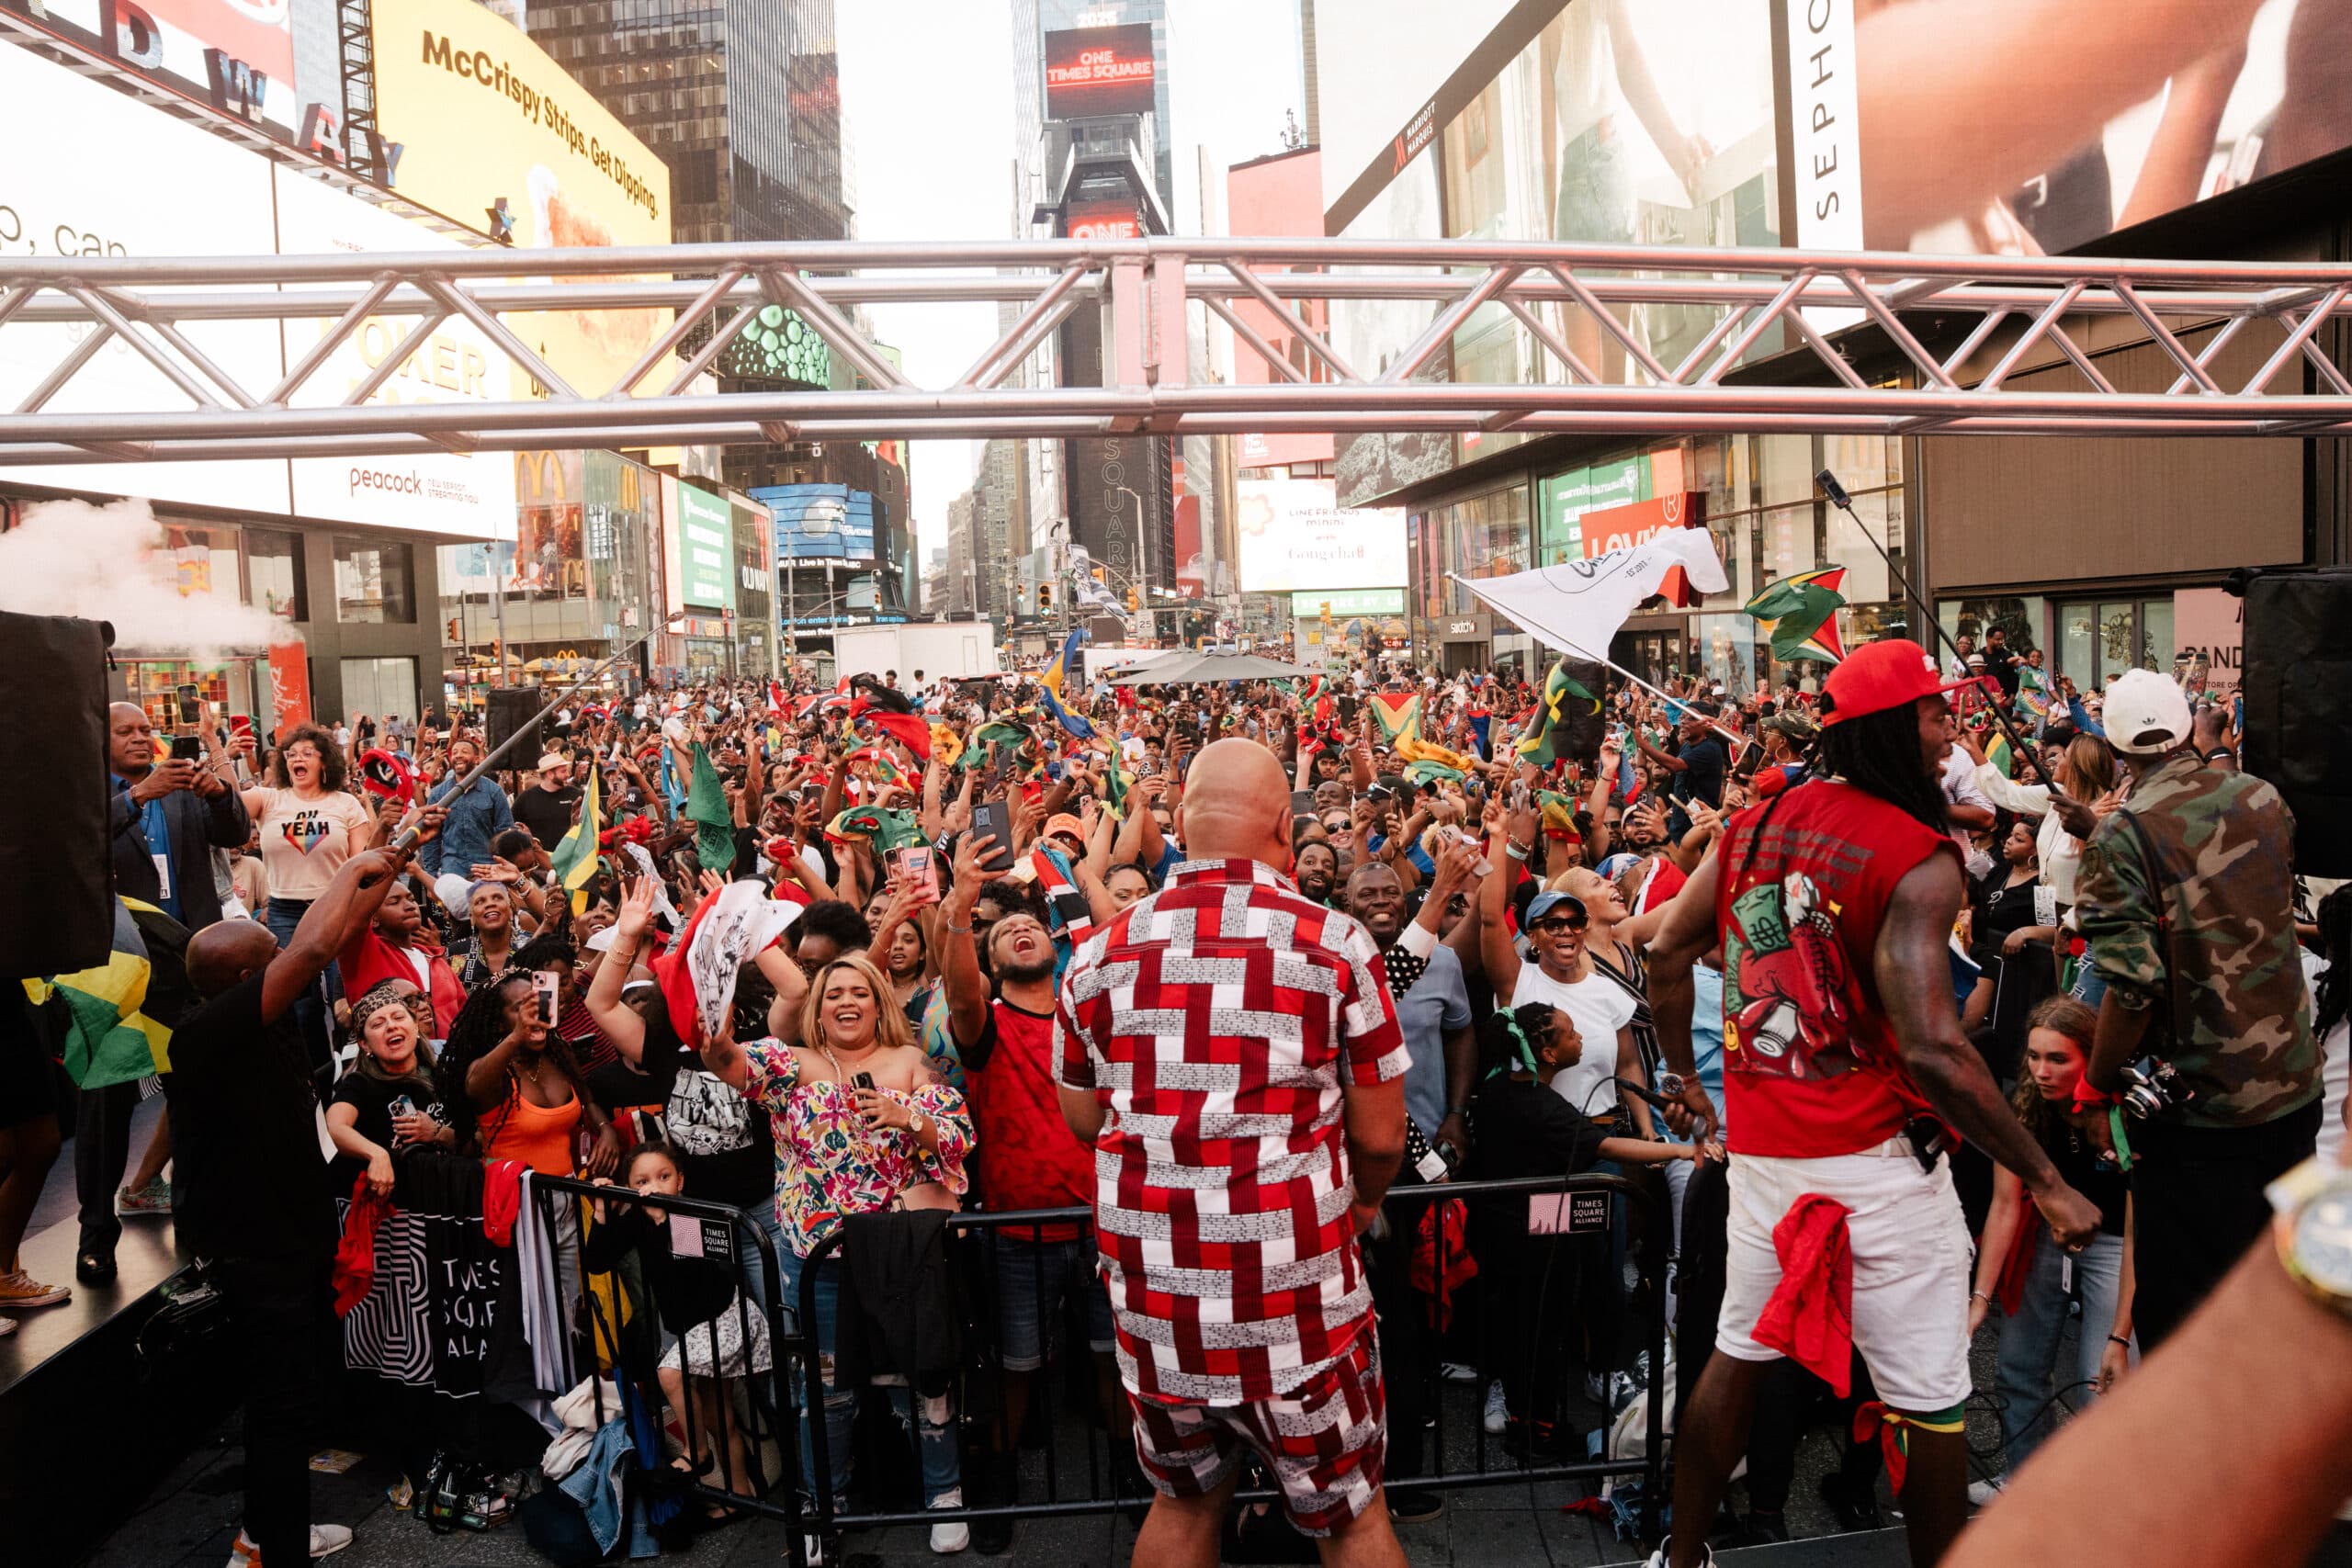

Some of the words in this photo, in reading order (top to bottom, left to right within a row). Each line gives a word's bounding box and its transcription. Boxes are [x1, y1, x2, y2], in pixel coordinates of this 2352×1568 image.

[1080, 51, 1114, 65] ONE
[1047, 65, 1091, 82] TIMES
[1093, 61, 1152, 78] SQUARE
[1807, 0, 1839, 220] SEPHO
[421, 28, 541, 125] McCrispy
[544, 95, 589, 158] Strips.
[591, 136, 613, 178] Get
[614, 156, 659, 220] Dipping.
[1407, 101, 1435, 140] MARRIOTT
[1408, 122, 1433, 155] MARQUIS
[1073, 221, 1134, 240] ONE
[350, 467, 422, 497] peacock
[1289, 509, 1314, 517] LINE
[1315, 507, 1361, 516] FRIENDS
[1306, 517, 1345, 527] minini
[742, 565, 755, 590] OLD
[1139, 620, 1152, 629] 25
[1450, 620, 1470, 634] swatch
[2185, 646, 2242, 669] ND
[281, 821, 331, 837] YEAH
[1576, 1200, 1603, 1209] TIMES
[1572, 1208, 1606, 1218] SQUARE
[705, 1227, 727, 1238] TIMES
[704, 1235, 729, 1247] SQUARE
[707, 1245, 729, 1255] ALLIANCE
